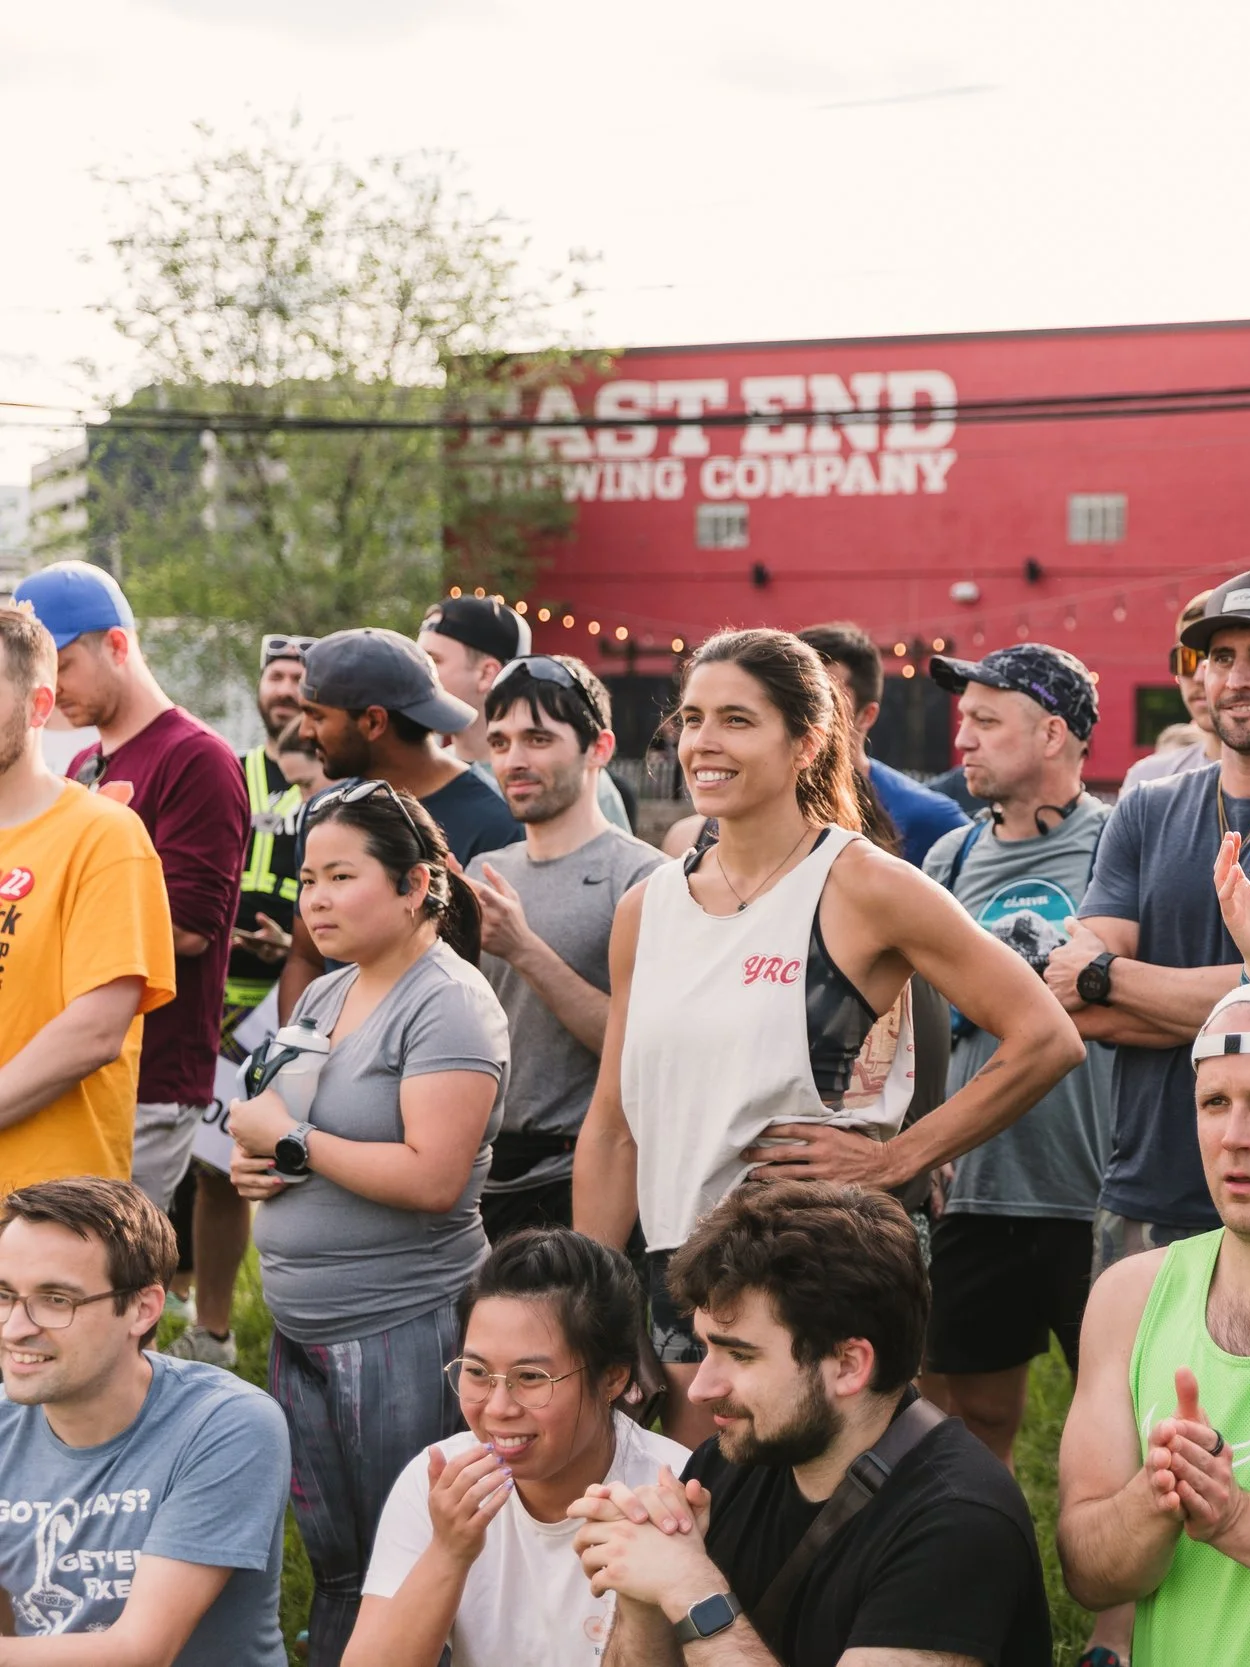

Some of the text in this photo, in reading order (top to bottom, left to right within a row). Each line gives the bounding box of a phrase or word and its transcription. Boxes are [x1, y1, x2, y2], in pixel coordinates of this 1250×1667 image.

[741, 369, 957, 455] END
[701, 449, 957, 499] COMPANY
[743, 954, 802, 986] YRC
